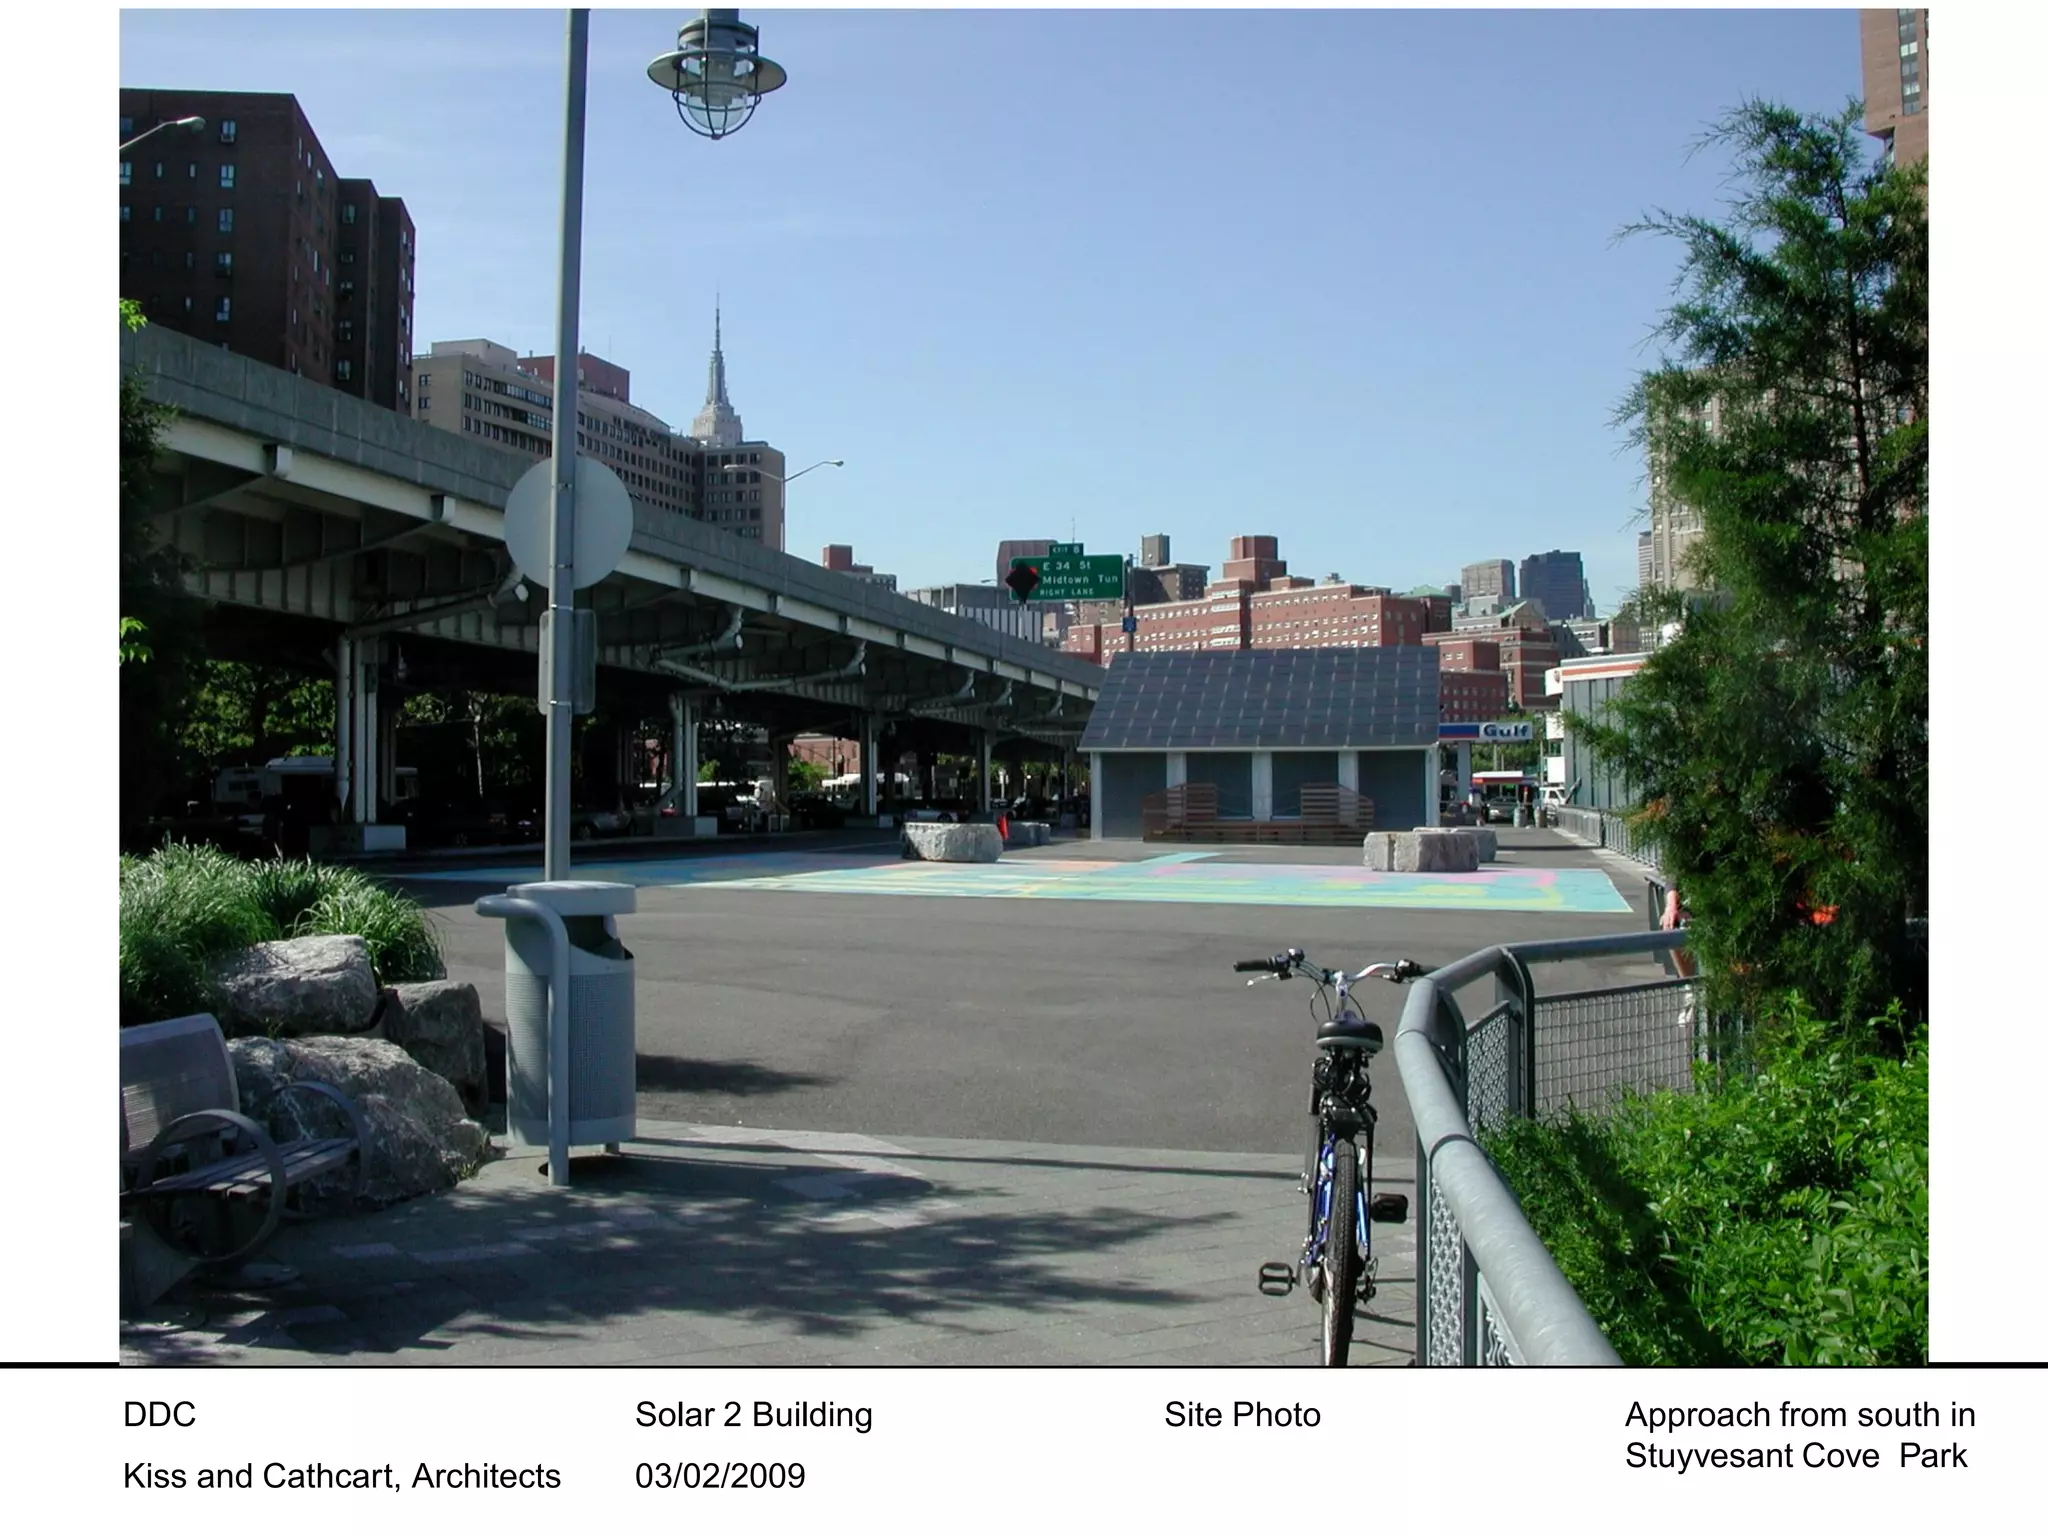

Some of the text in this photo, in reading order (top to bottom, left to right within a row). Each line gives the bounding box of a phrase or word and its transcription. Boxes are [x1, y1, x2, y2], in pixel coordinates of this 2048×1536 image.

[1043, 560, 1091, 571] E 34 St
[1042, 574, 1118, 585] Midtown Tun
[1040, 587, 1094, 597] RIGHT LANE
[1483, 723, 1529, 737] Gulf
